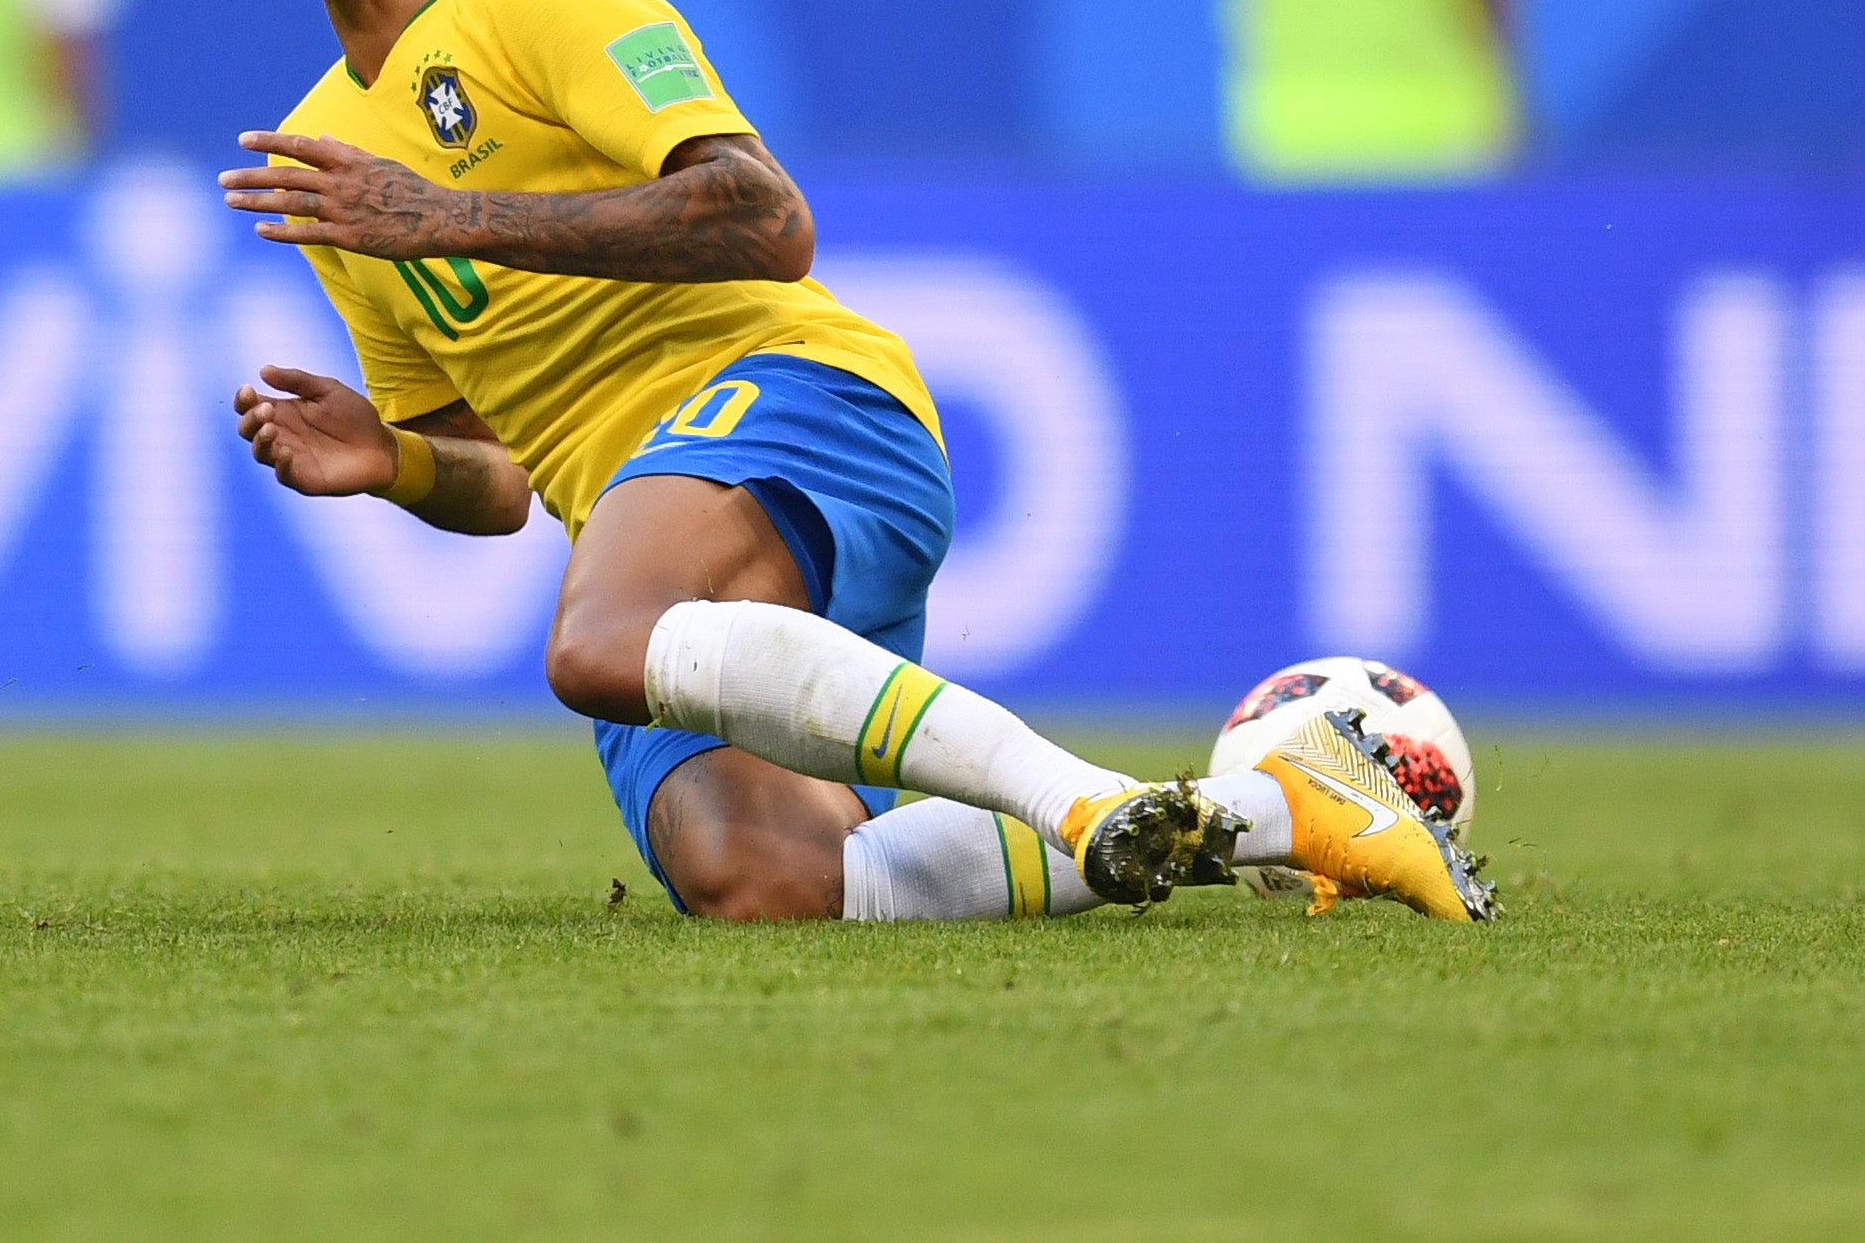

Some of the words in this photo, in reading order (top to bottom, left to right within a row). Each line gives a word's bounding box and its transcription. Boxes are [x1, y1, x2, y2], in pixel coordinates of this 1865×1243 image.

[438, 98, 453, 115] CBF
[449, 138, 503, 179] BRASIL
[393, 257, 489, 343] 10
[1299, 268, 1865, 674] N
